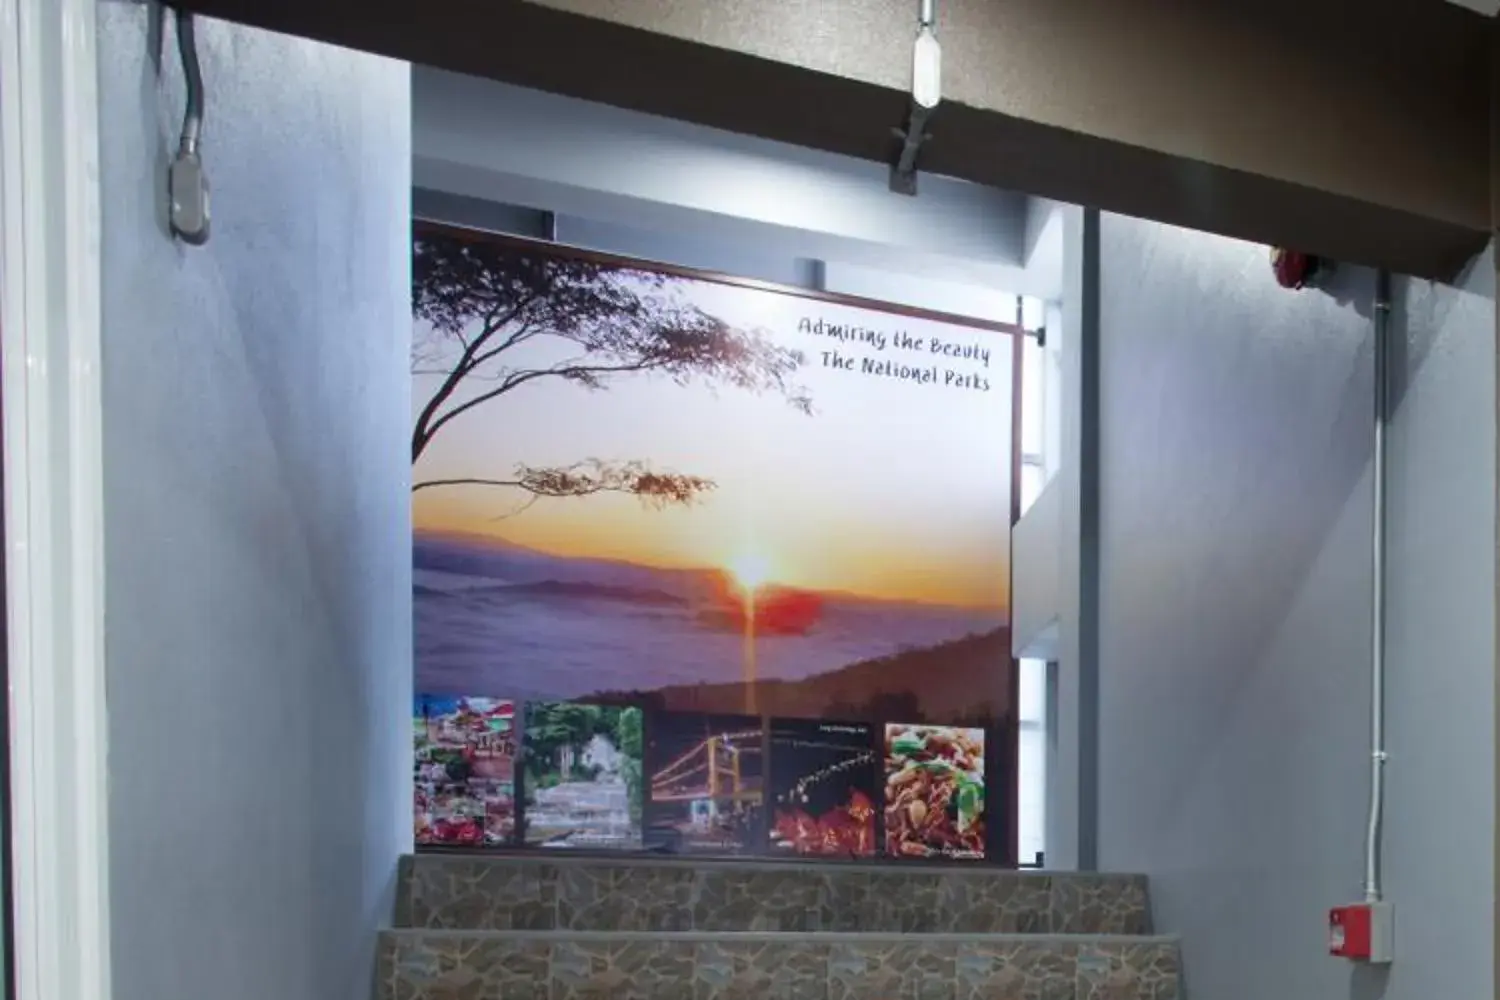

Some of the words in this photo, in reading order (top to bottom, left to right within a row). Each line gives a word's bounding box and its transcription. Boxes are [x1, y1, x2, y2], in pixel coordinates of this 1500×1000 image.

[797, 316, 887, 350] Admiring
[893, 331, 924, 350] the
[930, 337, 990, 367] Beauty
[821, 351, 854, 371] The
[861, 357, 937, 384] National
[944, 370, 990, 391] Parks
